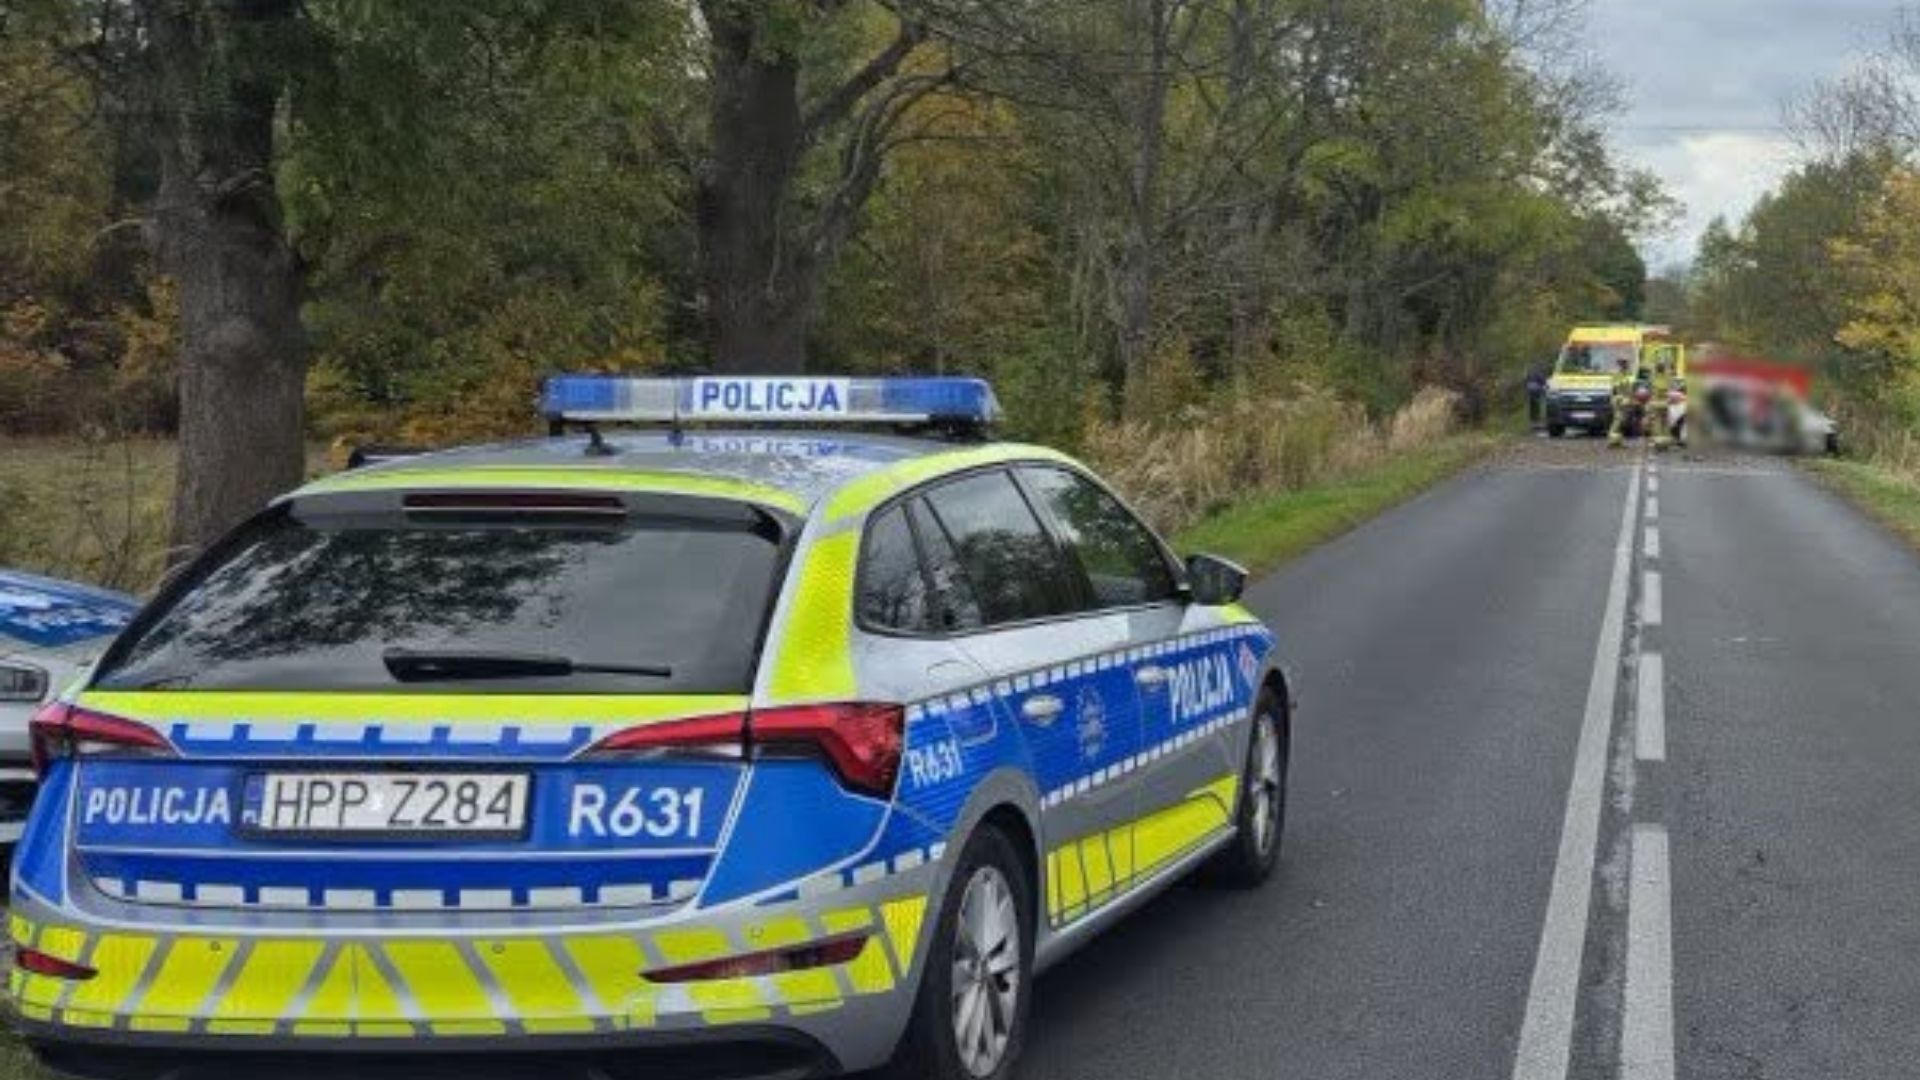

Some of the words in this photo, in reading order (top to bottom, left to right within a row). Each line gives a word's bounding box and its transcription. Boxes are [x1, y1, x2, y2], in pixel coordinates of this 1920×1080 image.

[702, 382, 841, 412] POLICJA
[1167, 652, 1234, 725] POLICJA
[909, 739, 963, 789] R631
[86, 787, 231, 824] POLICJA
[272, 781, 368, 828] HPP
[387, 781, 514, 826] Z284
[569, 783, 703, 838] R631
